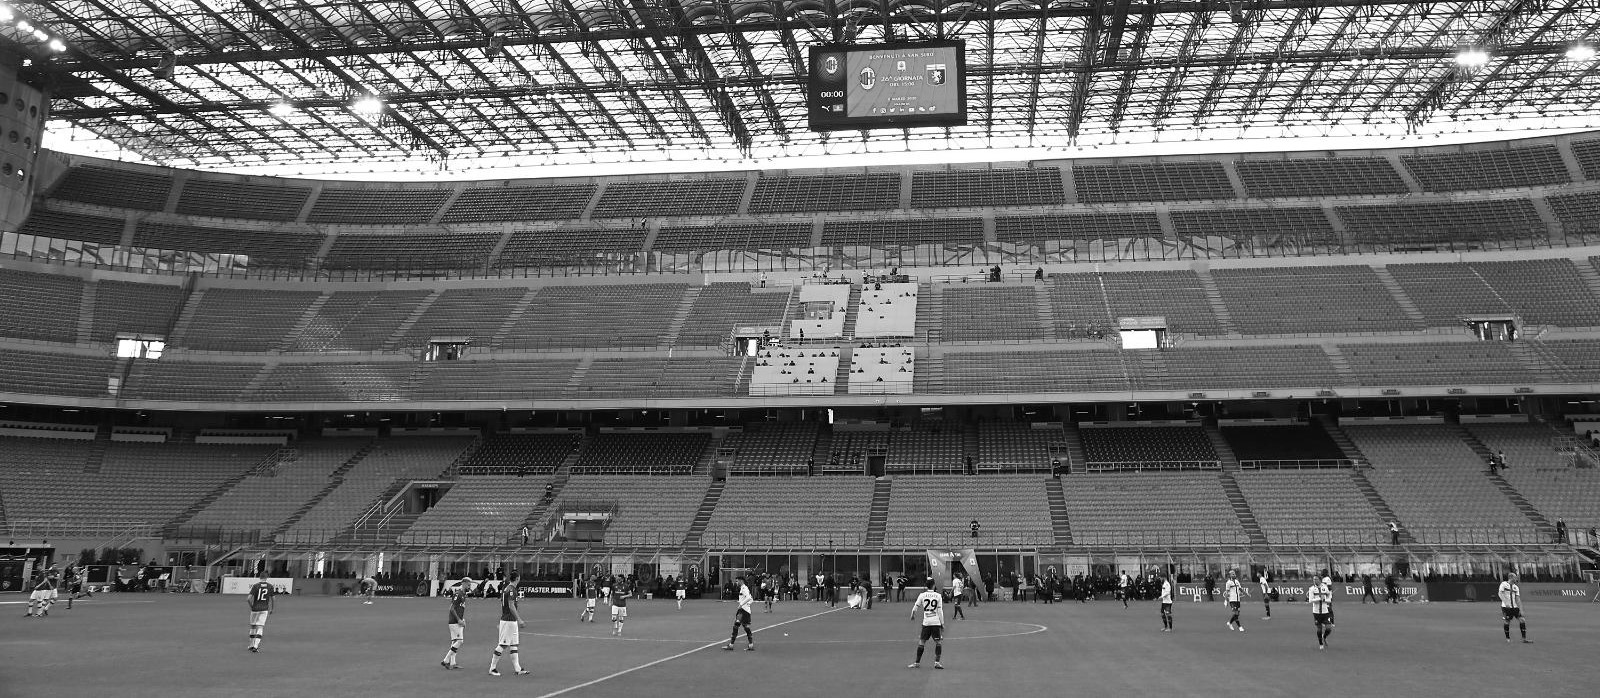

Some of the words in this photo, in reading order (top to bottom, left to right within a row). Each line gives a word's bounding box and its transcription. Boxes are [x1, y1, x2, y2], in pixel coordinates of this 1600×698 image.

[257, 588, 268, 601] 12
[527, 586, 550, 594] FASTER
[1179, 585, 1221, 596] Emiraes
[1345, 585, 1389, 596] Emites
[923, 598, 938, 612] 29
